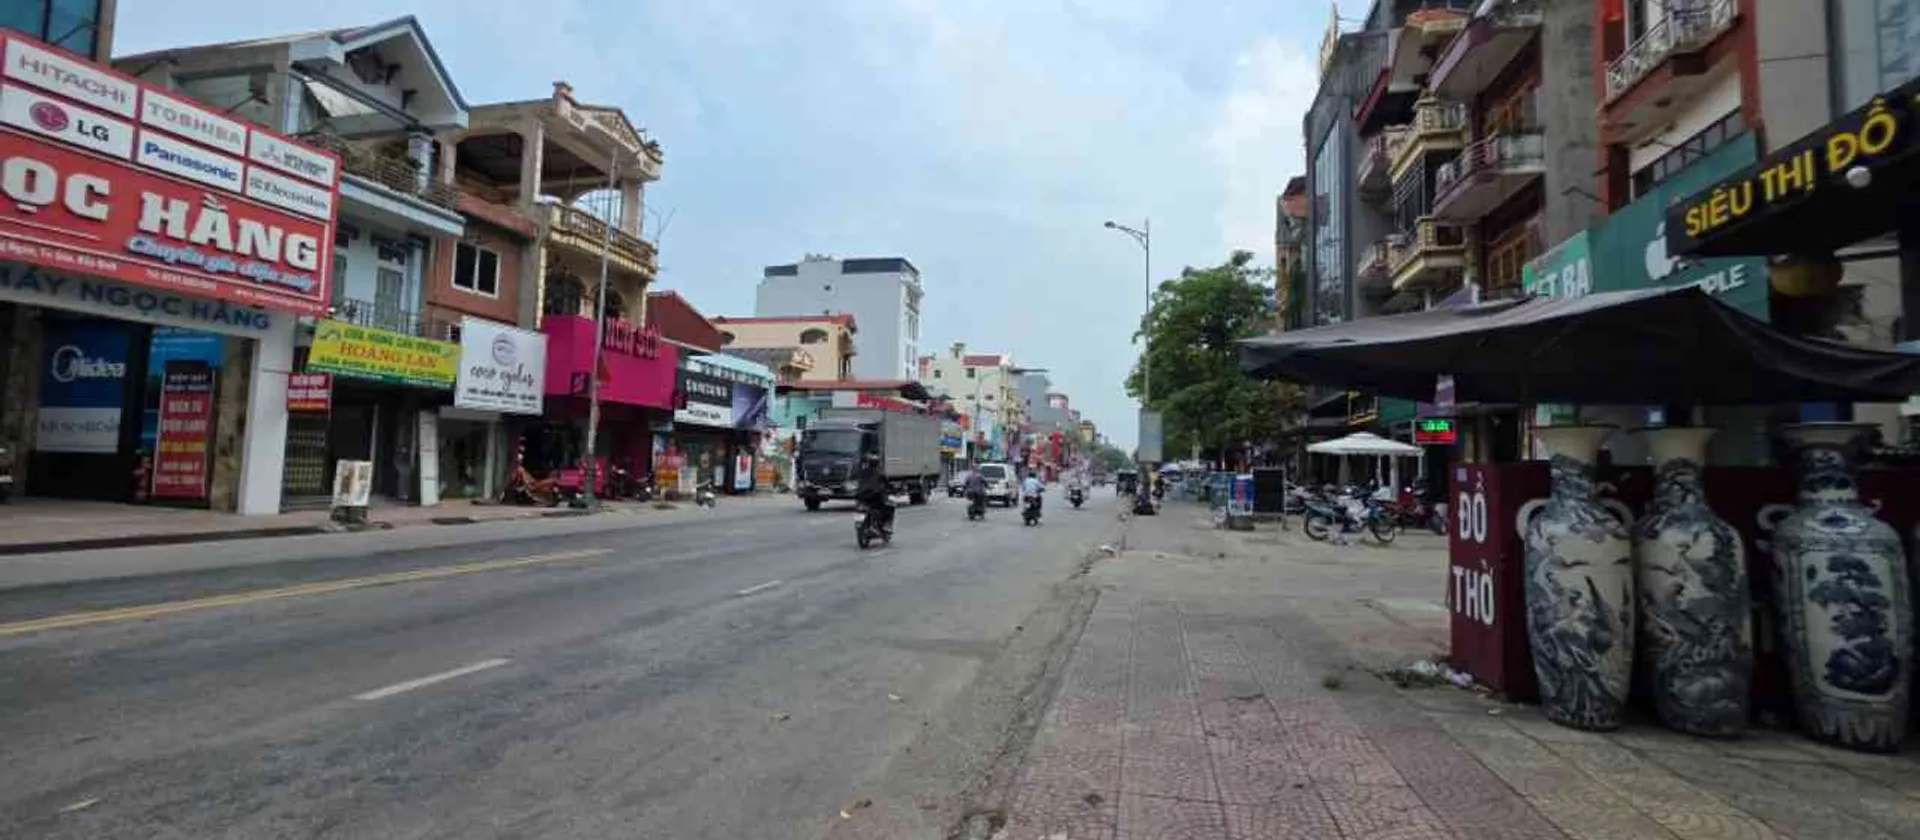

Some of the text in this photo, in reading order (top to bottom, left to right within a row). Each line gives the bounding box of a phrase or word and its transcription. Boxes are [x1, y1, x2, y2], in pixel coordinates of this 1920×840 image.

[20, 55, 126, 105] HITACHI
[76, 119, 109, 143] LG
[147, 100, 241, 146] TOSHIBA
[145, 142, 238, 181] Panasonic
[1685, 97, 1896, 238] SIÊU THỊ ĐỒ
[138, 192, 318, 271] HẰNG
[80, 280, 183, 320] NGỌC
[1458, 470, 1488, 544] ĐỒ
[1452, 558, 1495, 626] THỜ
